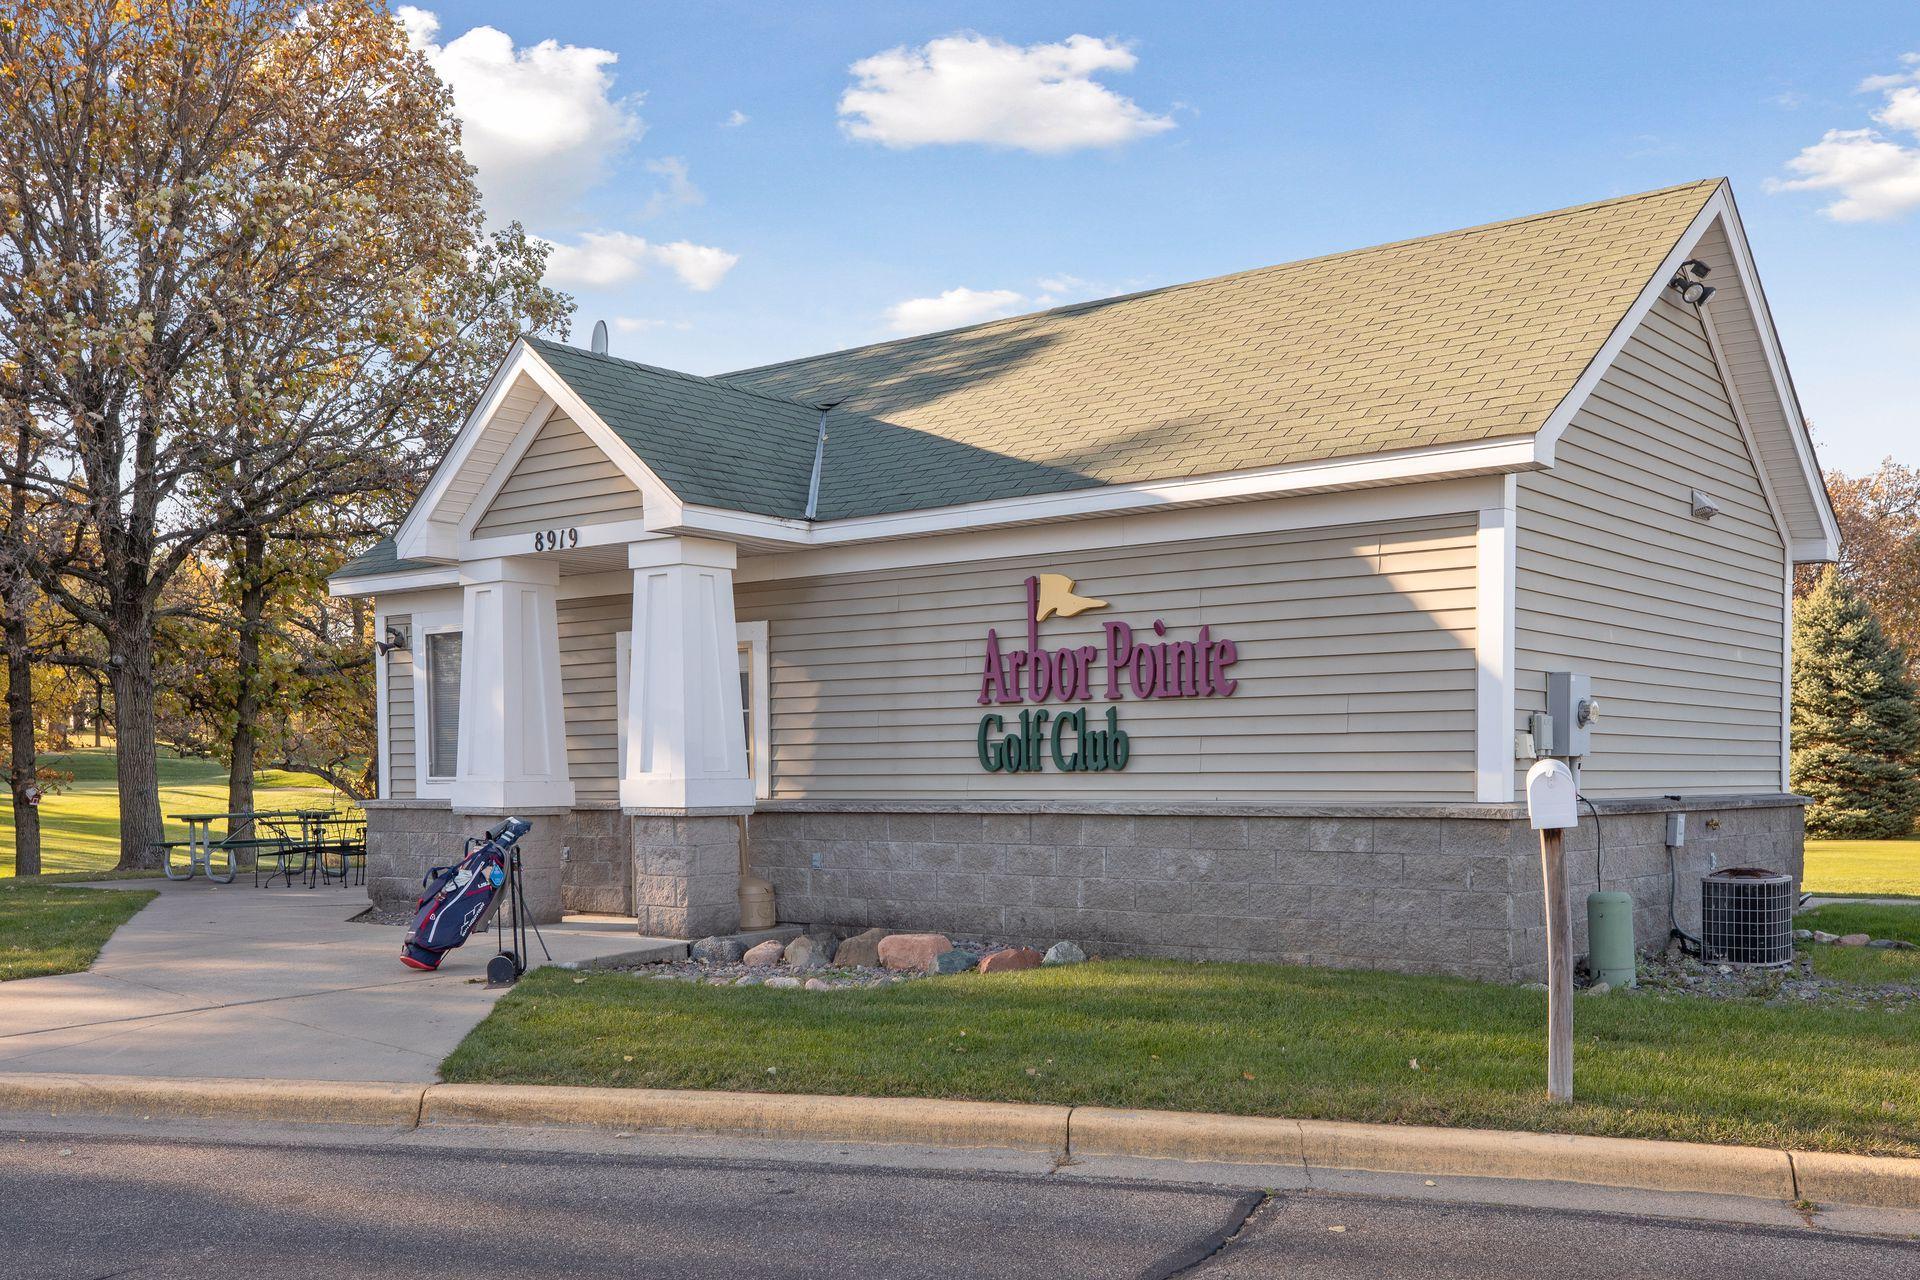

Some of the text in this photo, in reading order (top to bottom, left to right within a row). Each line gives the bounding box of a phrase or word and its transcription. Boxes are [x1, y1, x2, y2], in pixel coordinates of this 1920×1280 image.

[534, 527, 578, 552] 8919
[977, 576, 1238, 704] Arbor Pointe
[977, 705, 1130, 773] Golf Club
